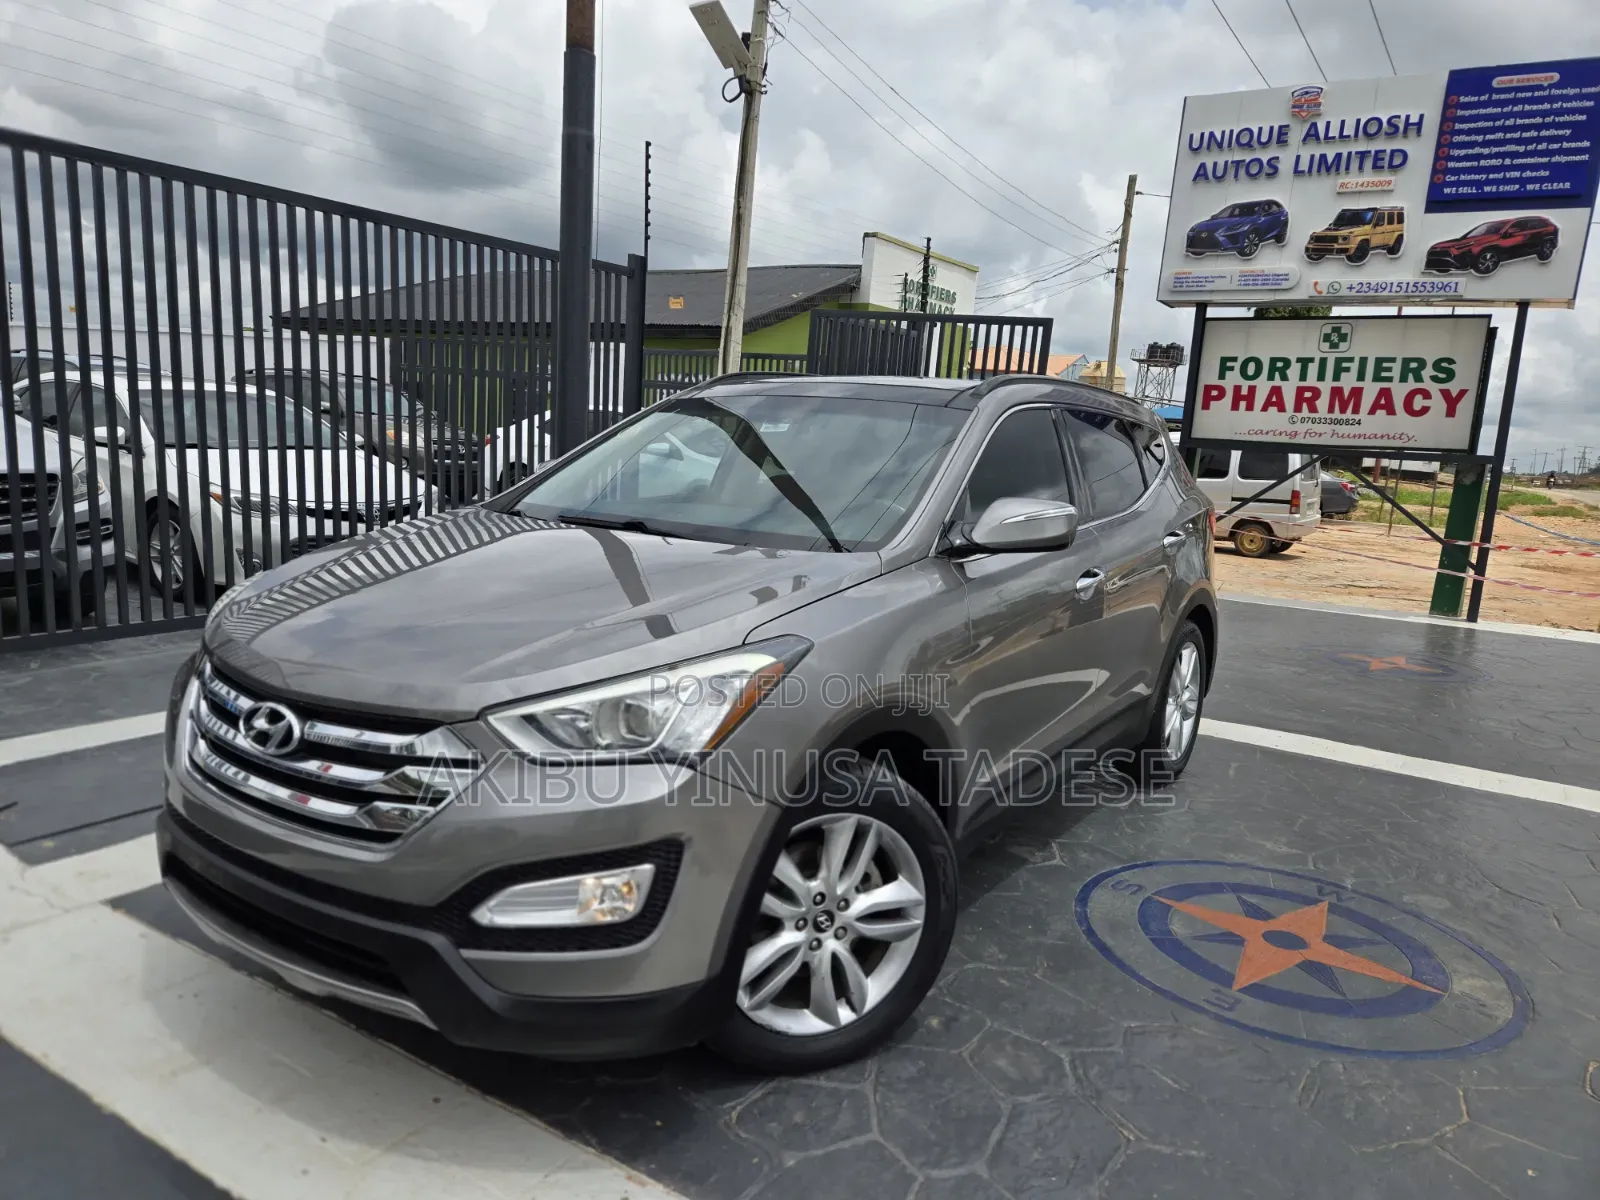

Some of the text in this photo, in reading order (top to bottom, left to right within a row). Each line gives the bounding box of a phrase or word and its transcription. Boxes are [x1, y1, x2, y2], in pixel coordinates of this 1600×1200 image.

[1492, 92, 1514, 100] brand
[1551, 87, 1580, 95] foreign
[1456, 107, 1501, 116] Importation
[1524, 103, 1551, 111] brands
[1552, 101, 1562, 109] of
[1563, 100, 1594, 108] vehicles
[1454, 120, 1493, 130] Inspection
[1495, 119, 1504, 127] of
[1504, 118, 1514, 126] all
[1516, 117, 1543, 125] brands
[1555, 114, 1587, 122] vehicles
[1188, 113, 1425, 152] UNIQUE ALLIOSH
[1452, 134, 1484, 142] Offering
[1485, 132, 1504, 140] swift
[1521, 130, 1538, 138] safe
[1450, 145, 1525, 156] Upgrading/profiling
[1562, 140, 1590, 148] brands
[1192, 148, 1409, 183] AUTOS LIMITED
[1551, 154, 1589, 163] shipment
[1460, 173, 1487, 181] history
[1522, 170, 1550, 178] checks
[1339, 179, 1392, 190] RC:1435009
[1542, 182, 1571, 190] CLEAR
[1346, 280, 1459, 294] +2349151553961
[1217, 356, 1457, 384] FORTIFIERS
[1200, 384, 1470, 418] PHARMACY
[1300, 416, 1362, 426] 07033300824
[1303, 428, 1327, 439] for
[1330, 429, 1417, 443] humanity.
